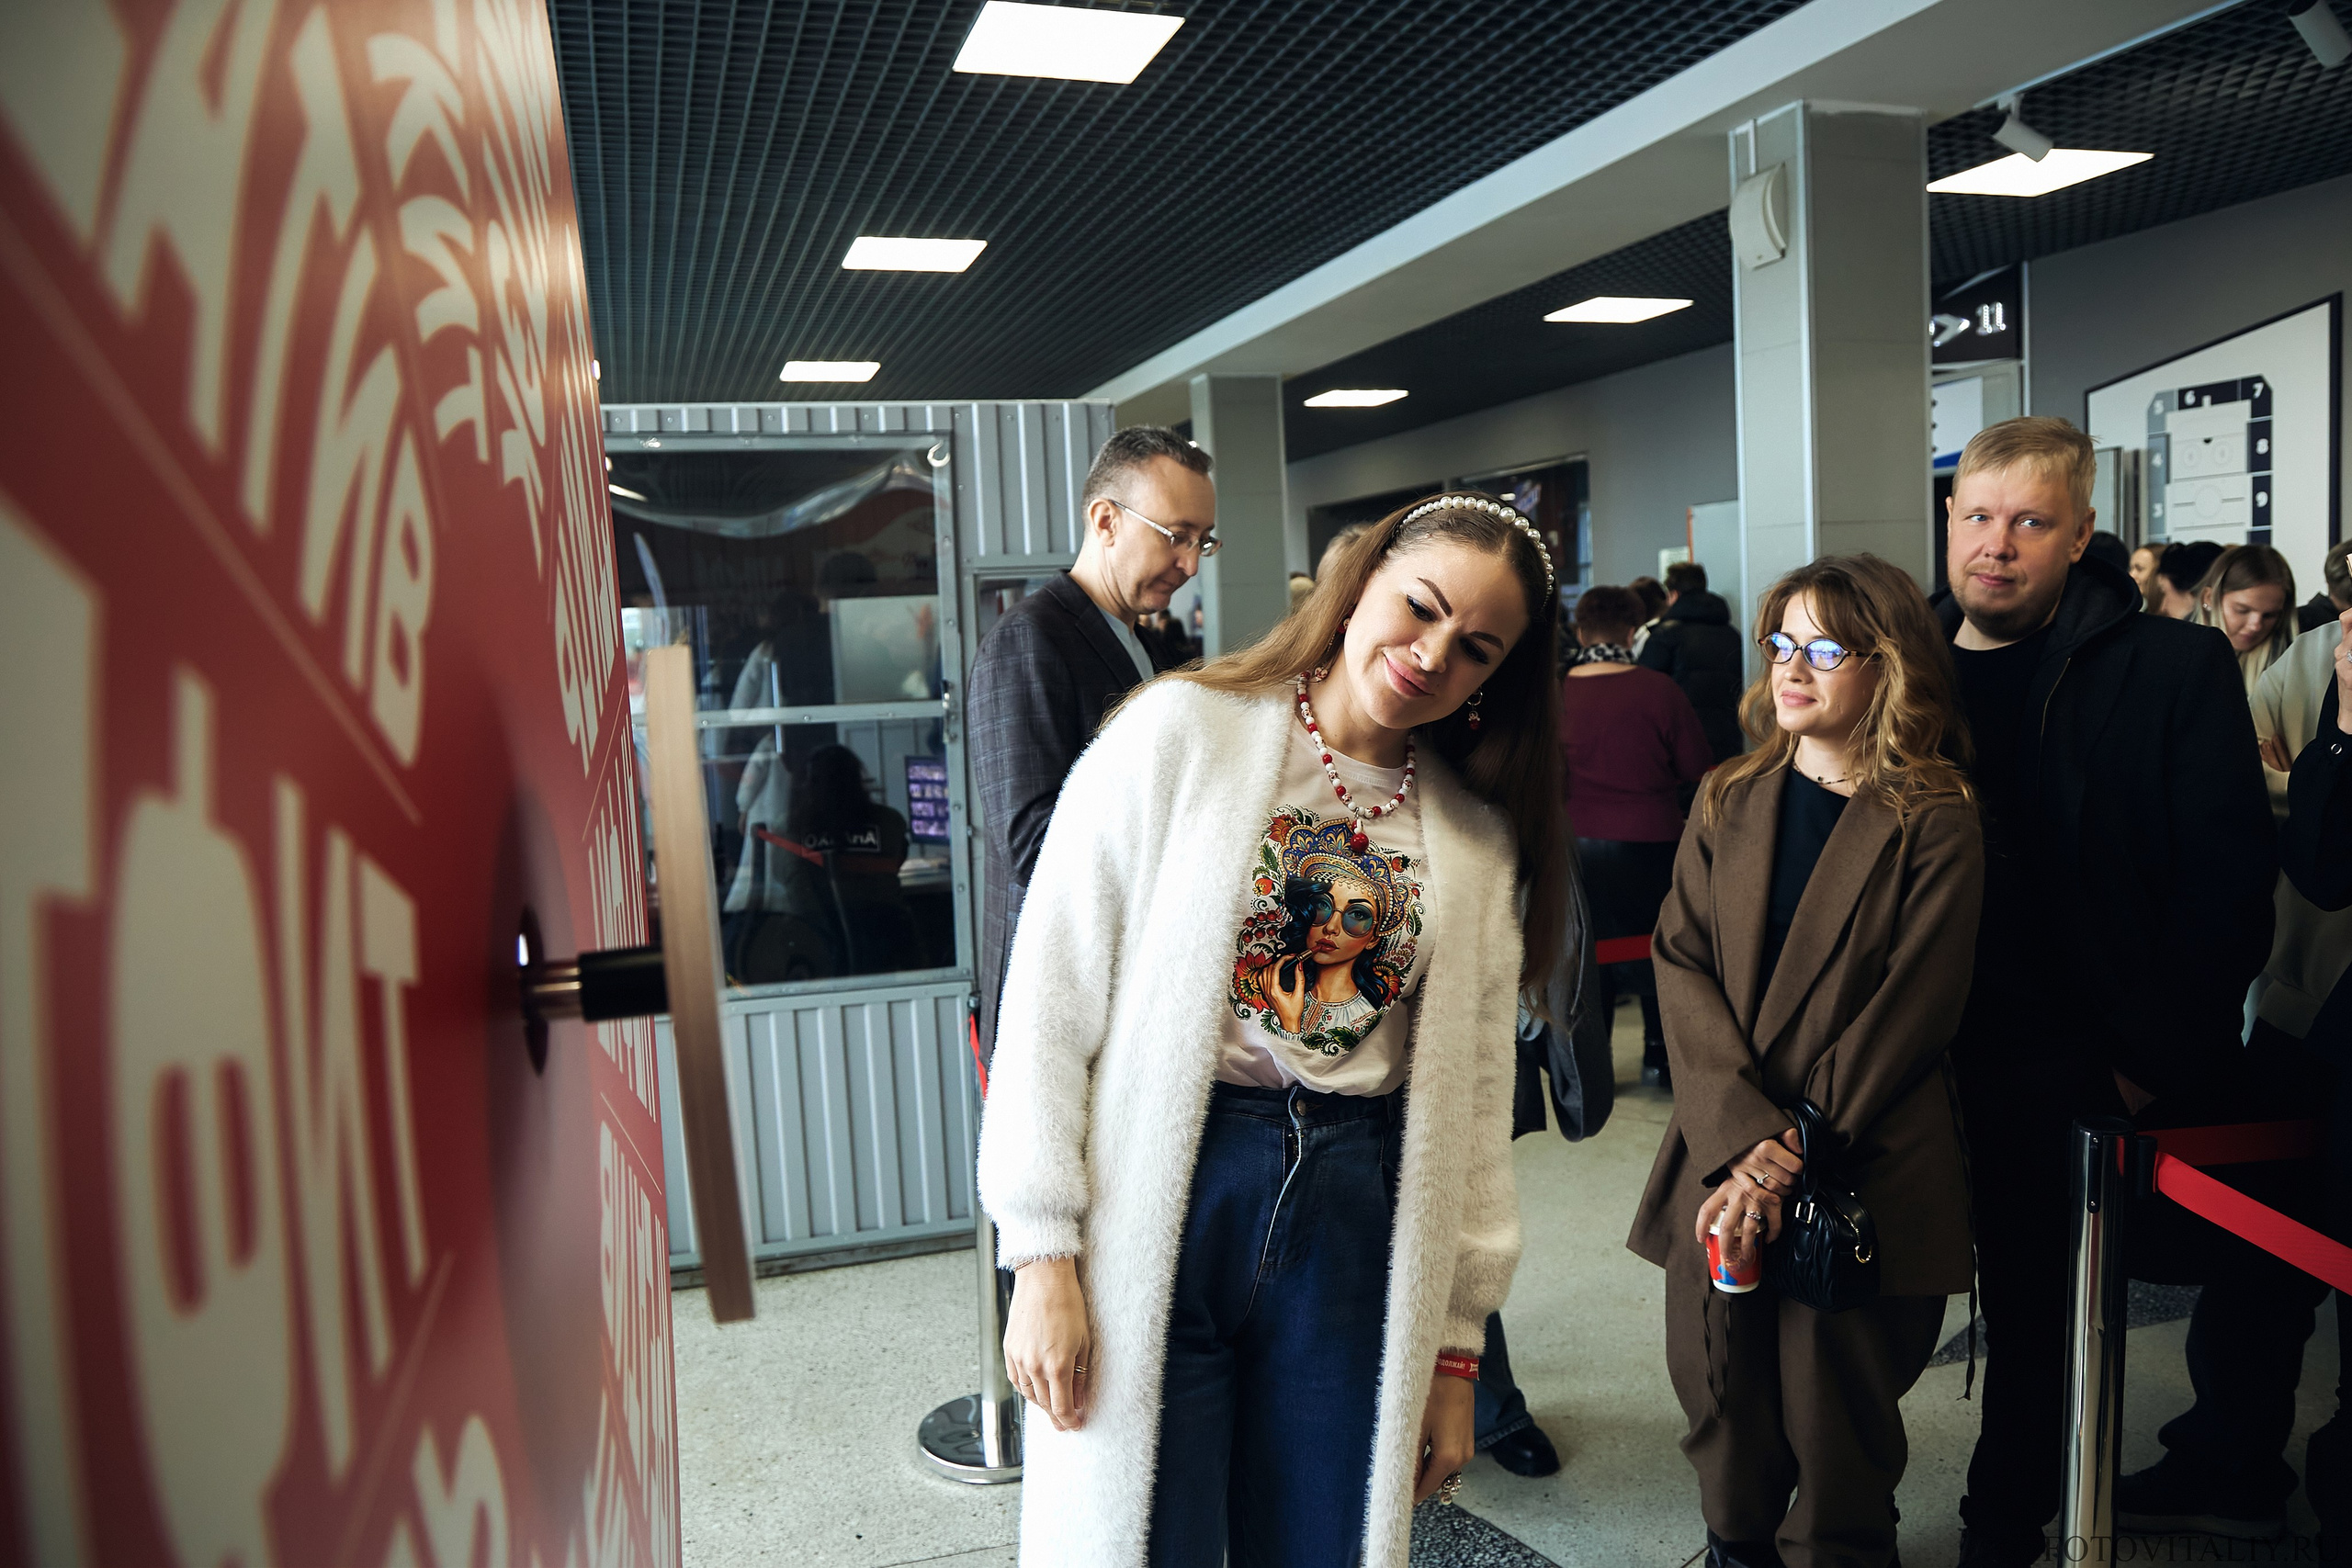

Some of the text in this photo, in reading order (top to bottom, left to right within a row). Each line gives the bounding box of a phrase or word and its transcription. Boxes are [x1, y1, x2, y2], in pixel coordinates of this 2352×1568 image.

[1976, 302, 2007, 336] 11
[2184, 389, 2196, 406] 6
[2252, 382, 2264, 399] 7
[2154, 400, 2165, 415] 5
[2256, 438, 2269, 455] 8
[2152, 453, 2163, 468] 4
[2256, 491, 2268, 508] 9
[2152, 502, 2164, 518] 3
